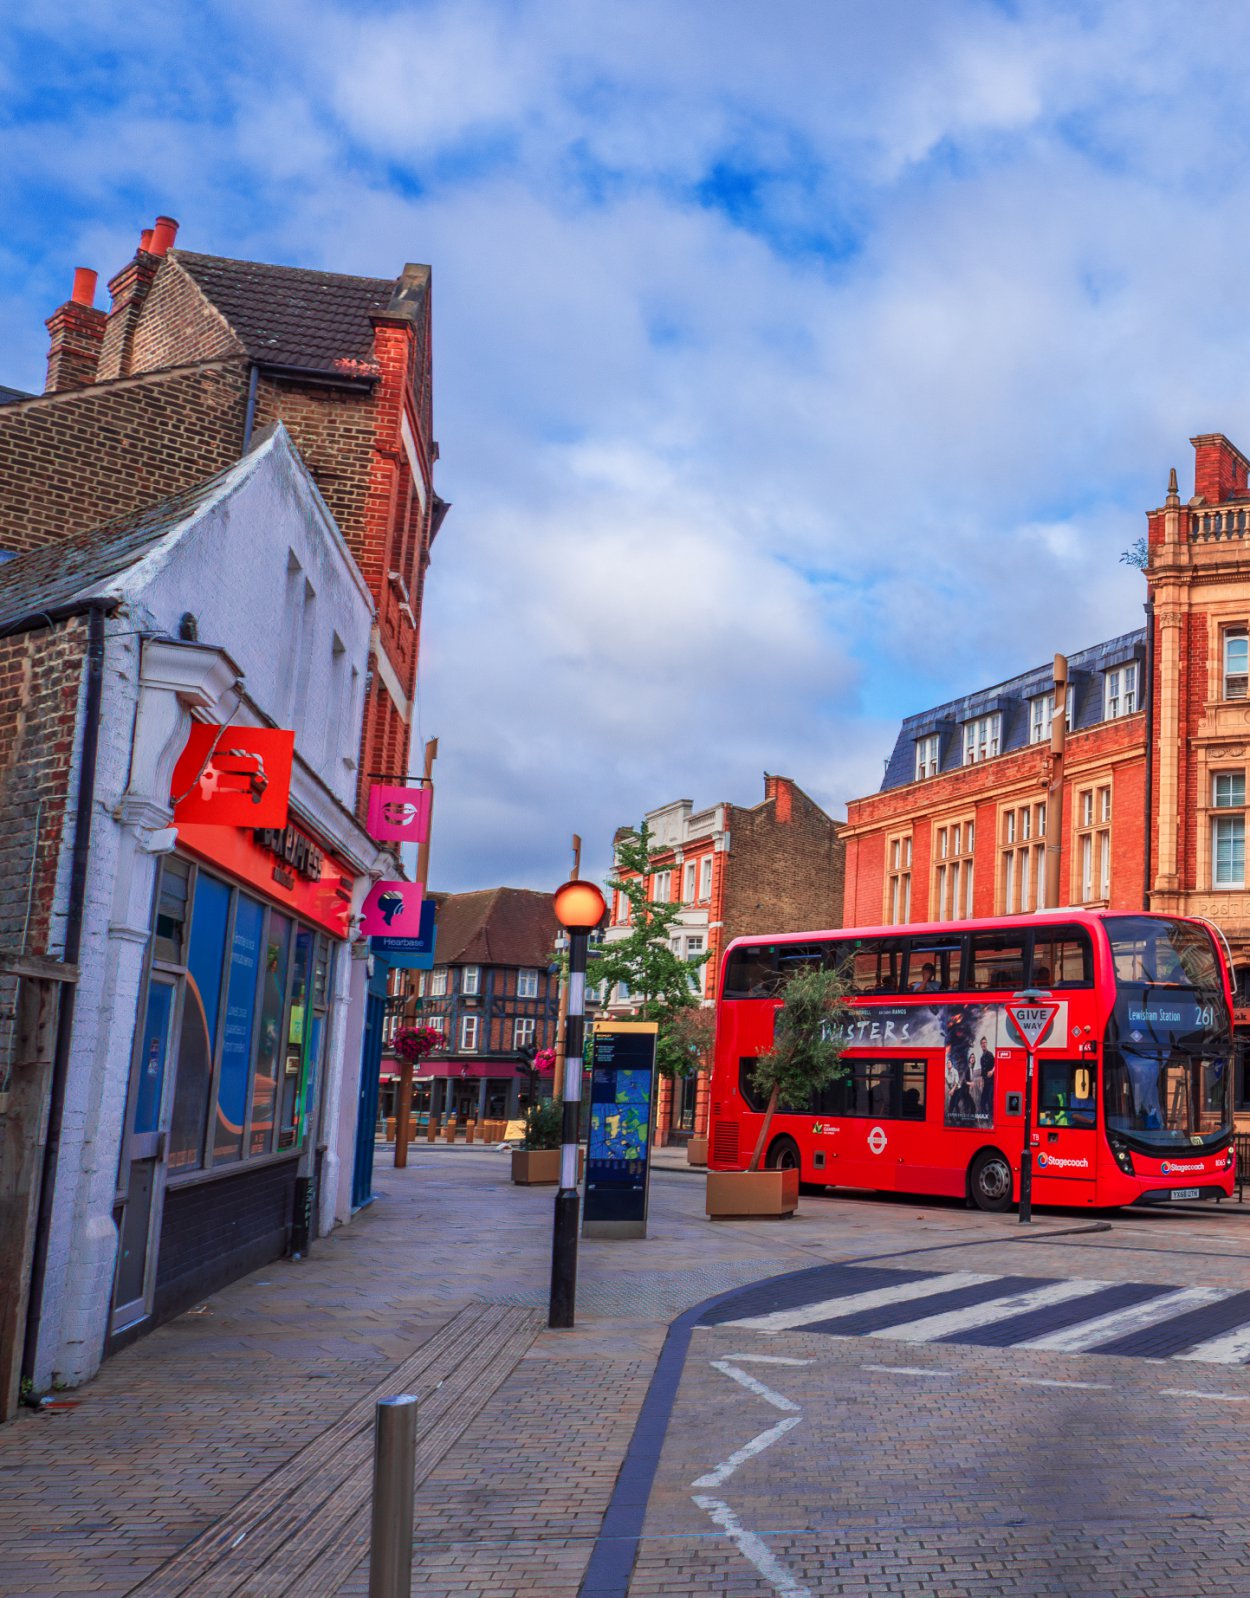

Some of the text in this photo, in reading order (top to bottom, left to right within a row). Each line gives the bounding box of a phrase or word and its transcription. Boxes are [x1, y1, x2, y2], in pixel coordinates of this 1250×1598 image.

[1200, 903, 1239, 916] POST
[383, 937, 424, 947] Hearbase
[1016, 1009, 1047, 1020] GIVE
[1128, 1006, 1214, 1026] Lewisham Station 261
[810, 1018, 910, 1041] WISTERS
[1023, 1022, 1043, 1030] WAY
[1048, 1155, 1089, 1168] Stagecoach
[1170, 1162, 1205, 1173] Stagecoach
